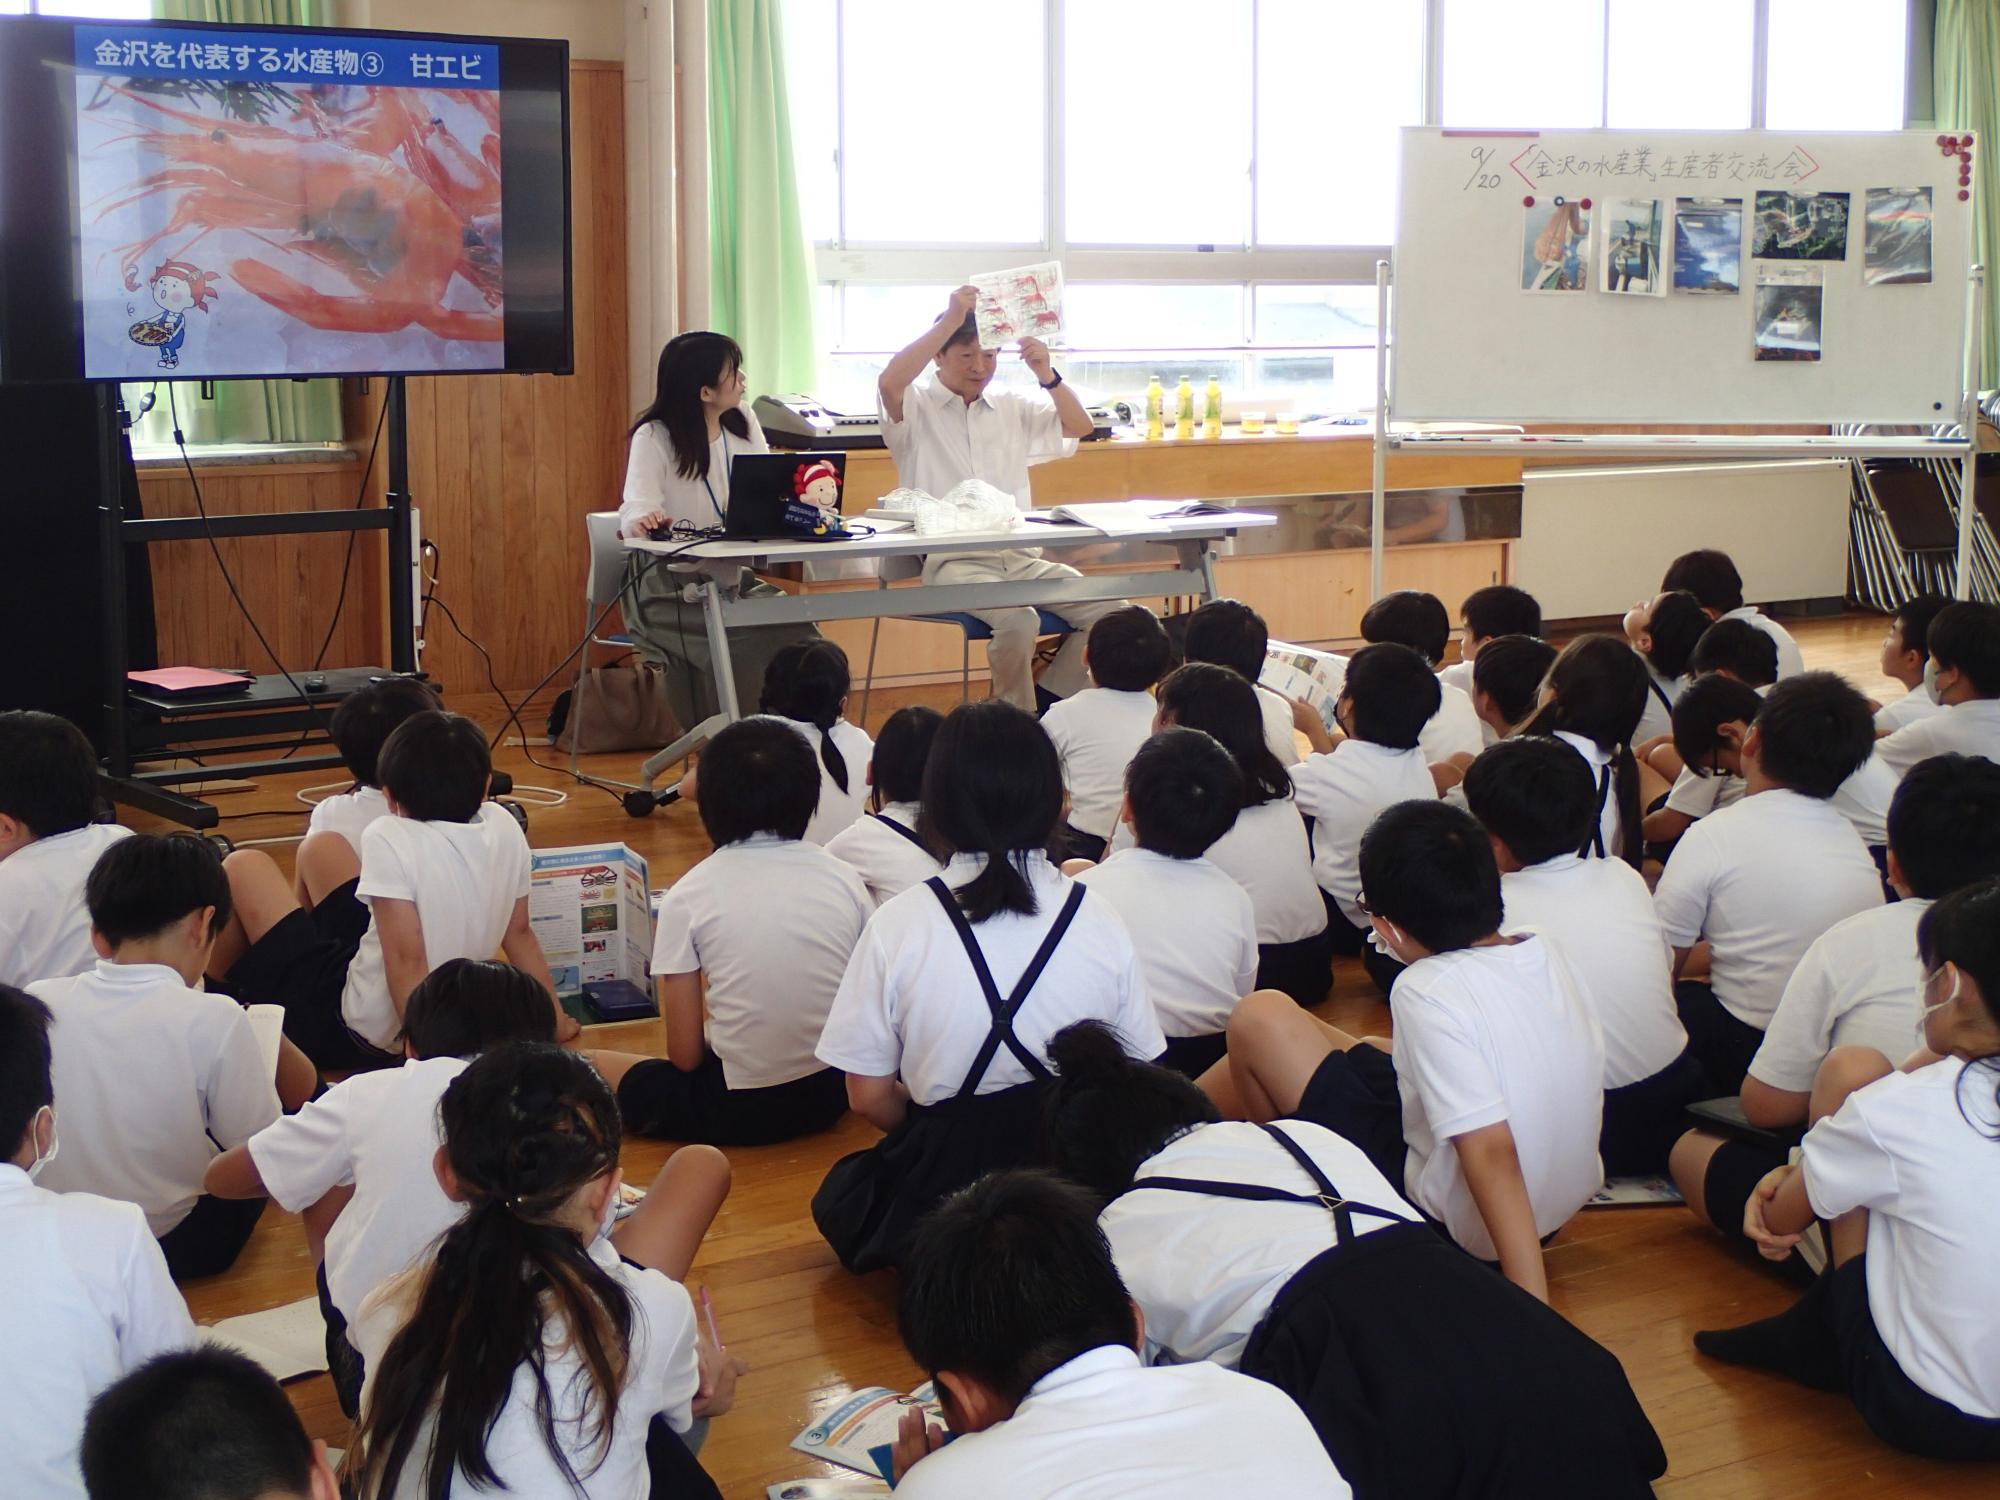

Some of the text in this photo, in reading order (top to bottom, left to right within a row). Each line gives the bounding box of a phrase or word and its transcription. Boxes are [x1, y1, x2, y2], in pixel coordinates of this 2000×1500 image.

[94, 38, 482, 80] 金沢を代表する水産物③ 甘エビ
